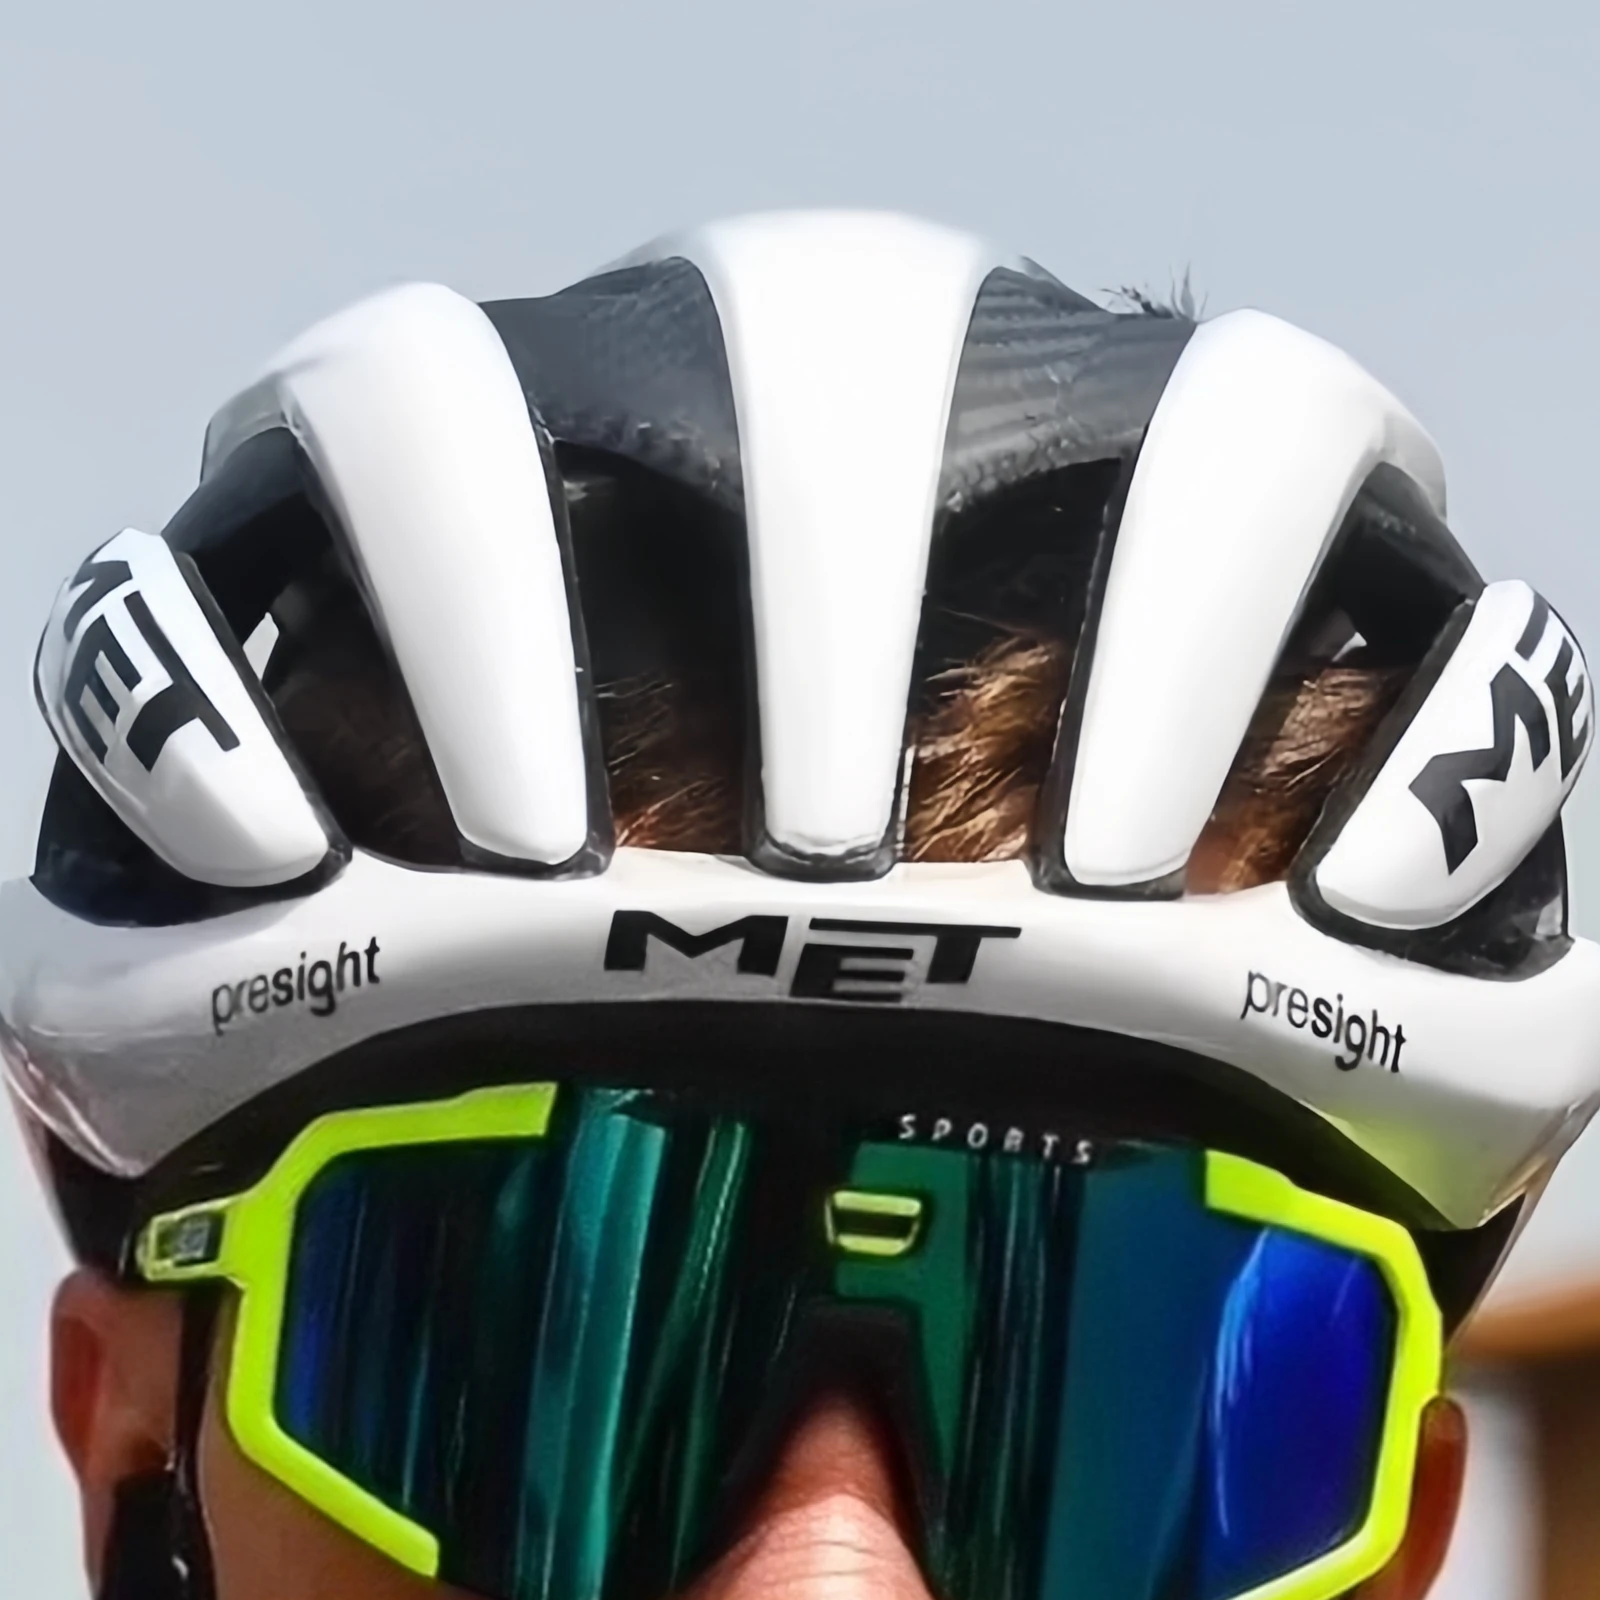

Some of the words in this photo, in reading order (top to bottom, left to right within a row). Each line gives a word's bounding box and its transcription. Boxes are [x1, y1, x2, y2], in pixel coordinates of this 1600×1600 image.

[212, 936, 381, 1036] presight
[604, 910, 1023, 1001] MET
[1240, 970, 1407, 1073] presight
[899, 1113, 1093, 1165] SPORTS
